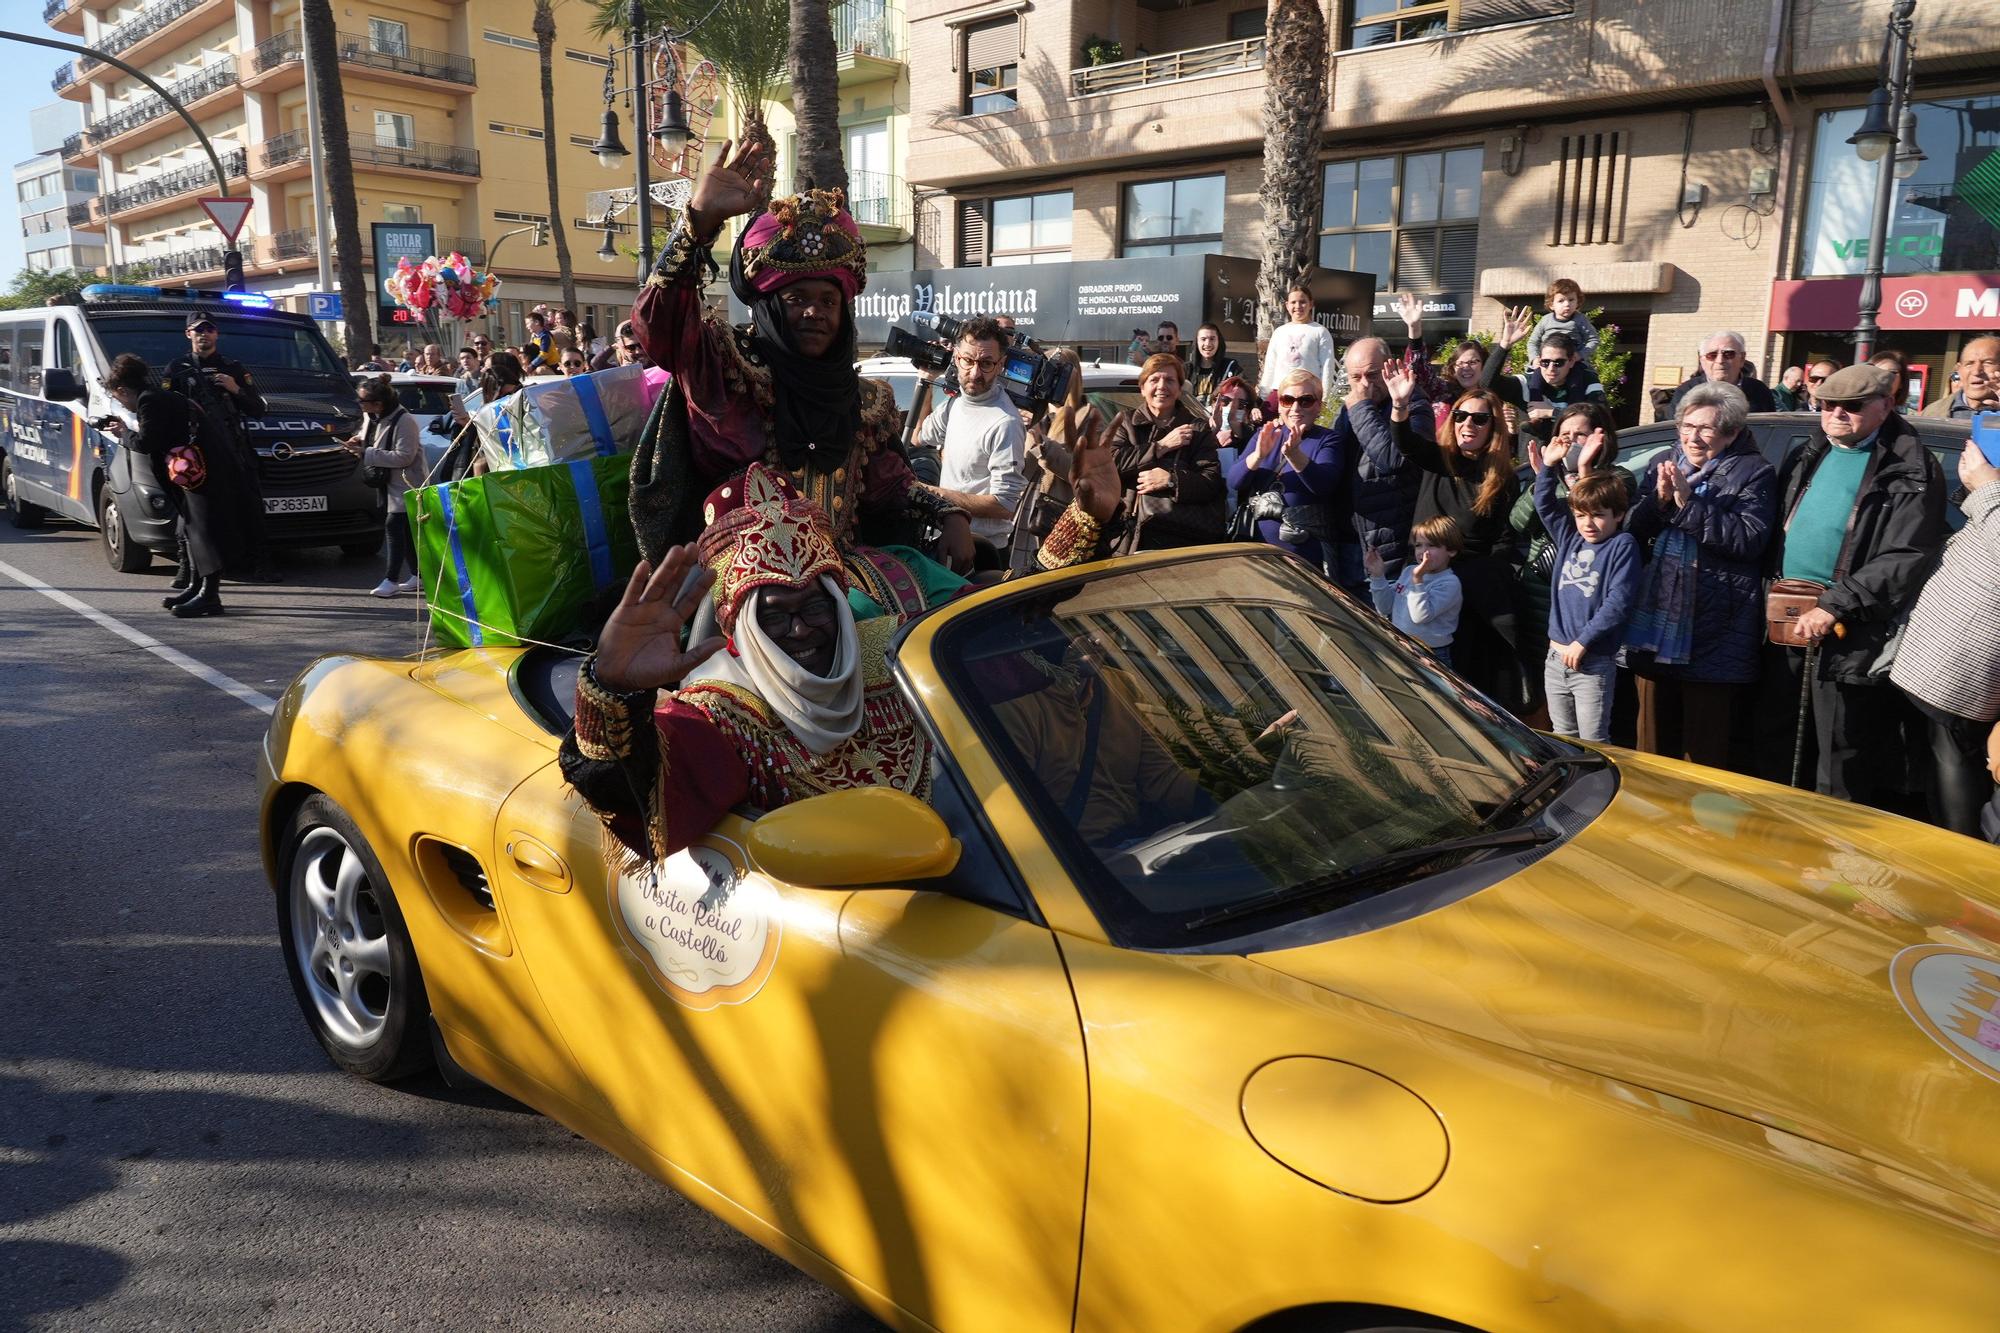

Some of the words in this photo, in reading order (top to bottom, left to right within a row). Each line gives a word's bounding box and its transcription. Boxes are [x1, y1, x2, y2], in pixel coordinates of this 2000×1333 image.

[386, 232, 422, 248] GRITAR
[1078, 284, 1113, 294] OBRADOR
[1114, 283, 1142, 293] PROPIO
[314, 298, 329, 314] P
[914, 282, 1038, 314] Valenciana
[1078, 296, 1088, 305] DE
[1089, 295, 1128, 305] HORCHATA,
[1129, 293, 1179, 303] GRANIZADOS
[1078, 307, 1084, 315] Y
[1084, 306, 1117, 315] HELADOS
[1118, 305, 1163, 315] ARTESANOS
[639, 876, 688, 915] Visita
[692, 900, 743, 941] Reial
[645, 915, 657, 930] a
[660, 915, 728, 962] Castelló
